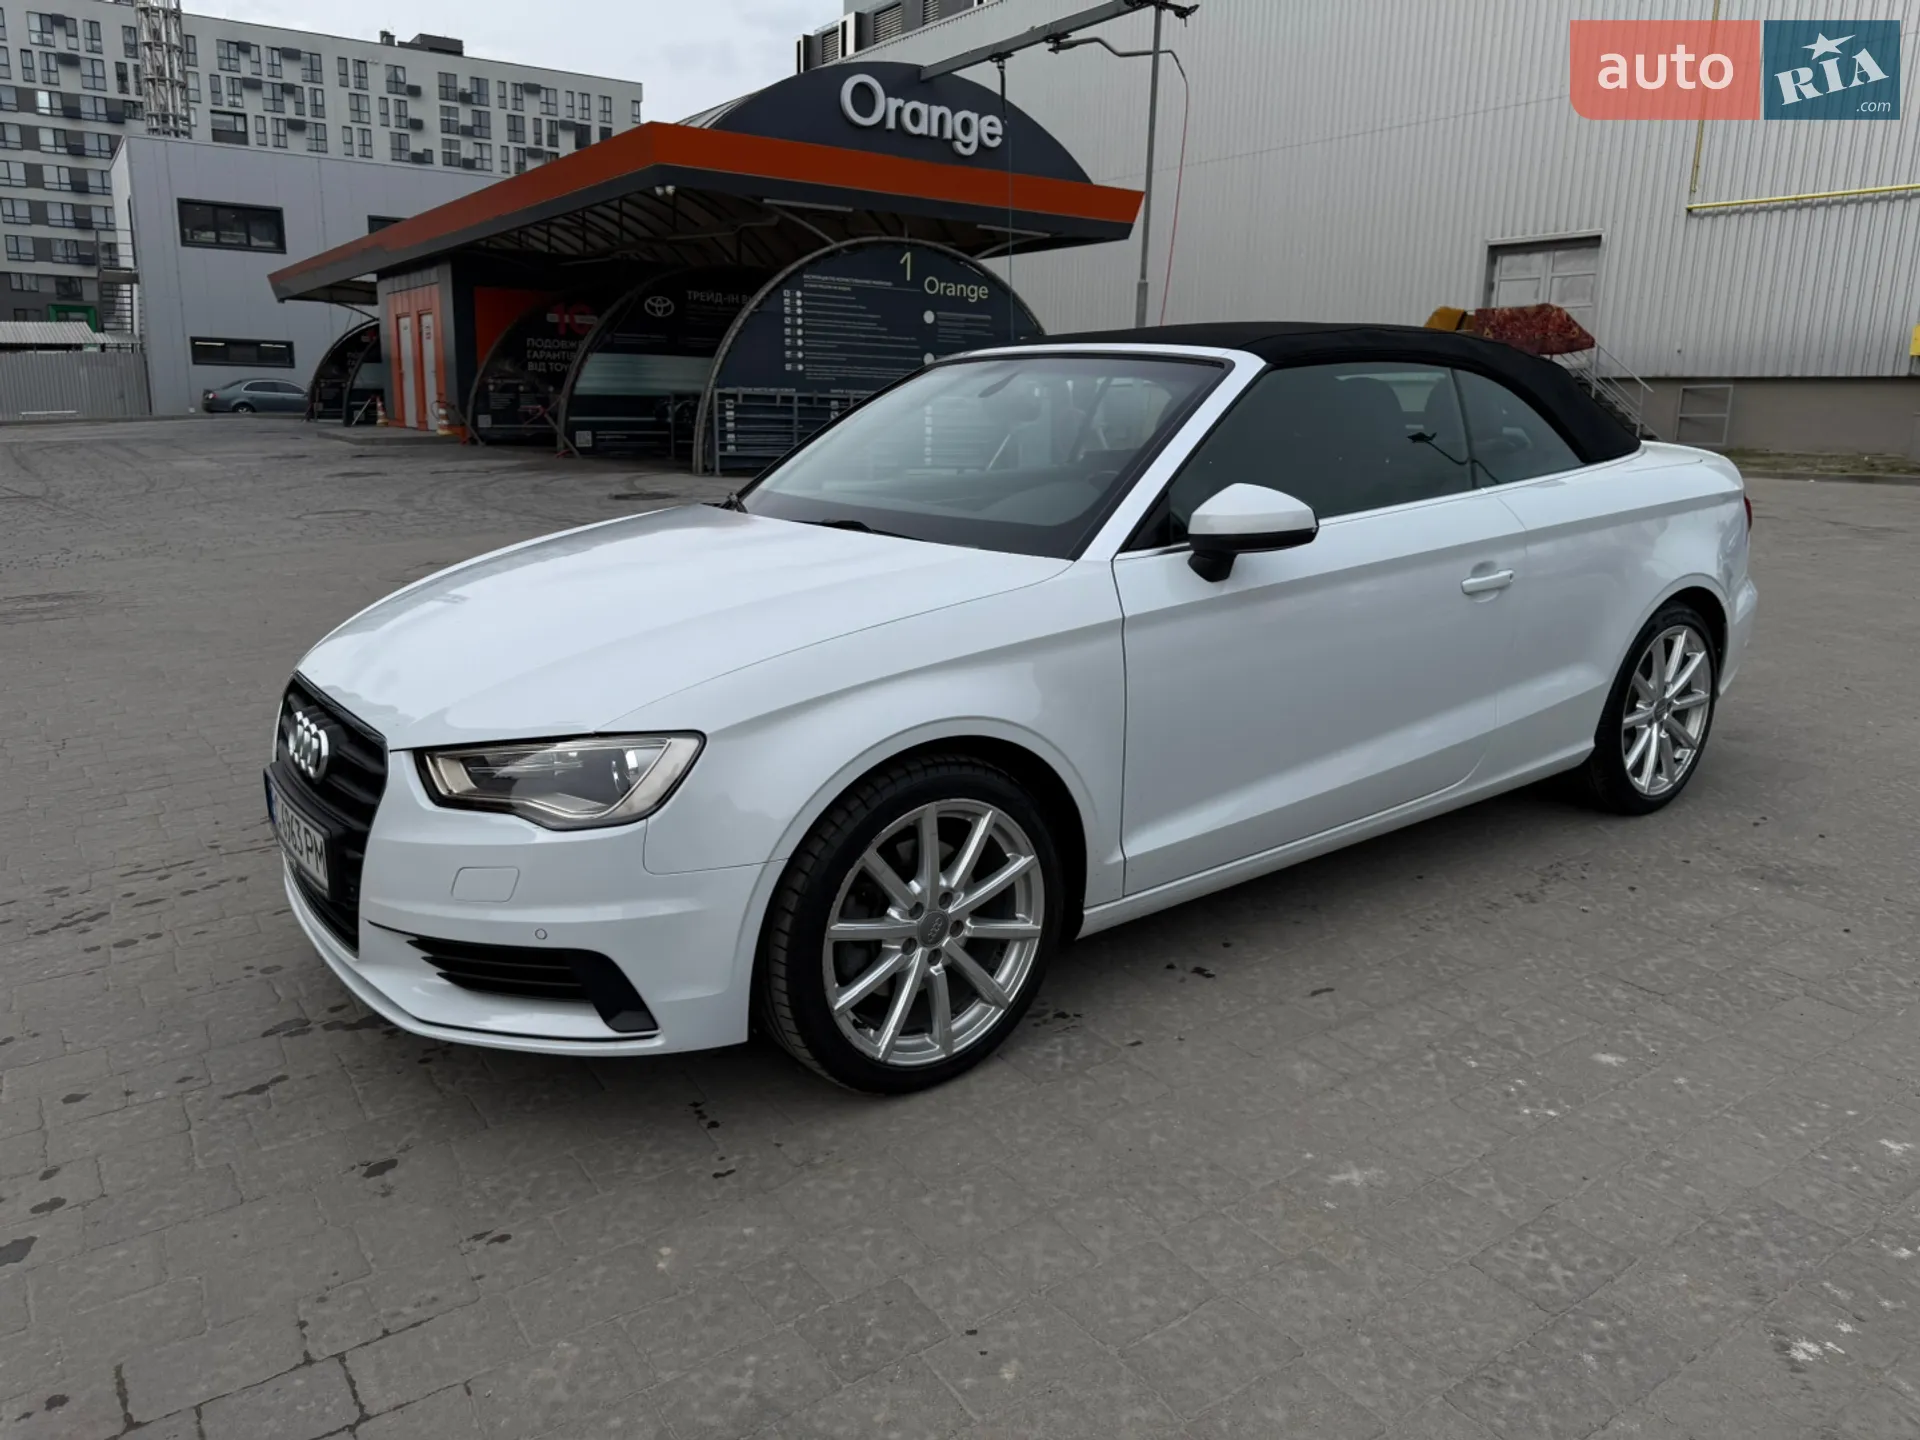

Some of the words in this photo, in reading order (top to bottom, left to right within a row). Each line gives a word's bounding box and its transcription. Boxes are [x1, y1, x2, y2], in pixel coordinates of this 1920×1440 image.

[840, 73, 1003, 157] Orange
[899, 251, 912, 282] 1
[923, 275, 989, 303] Orange
